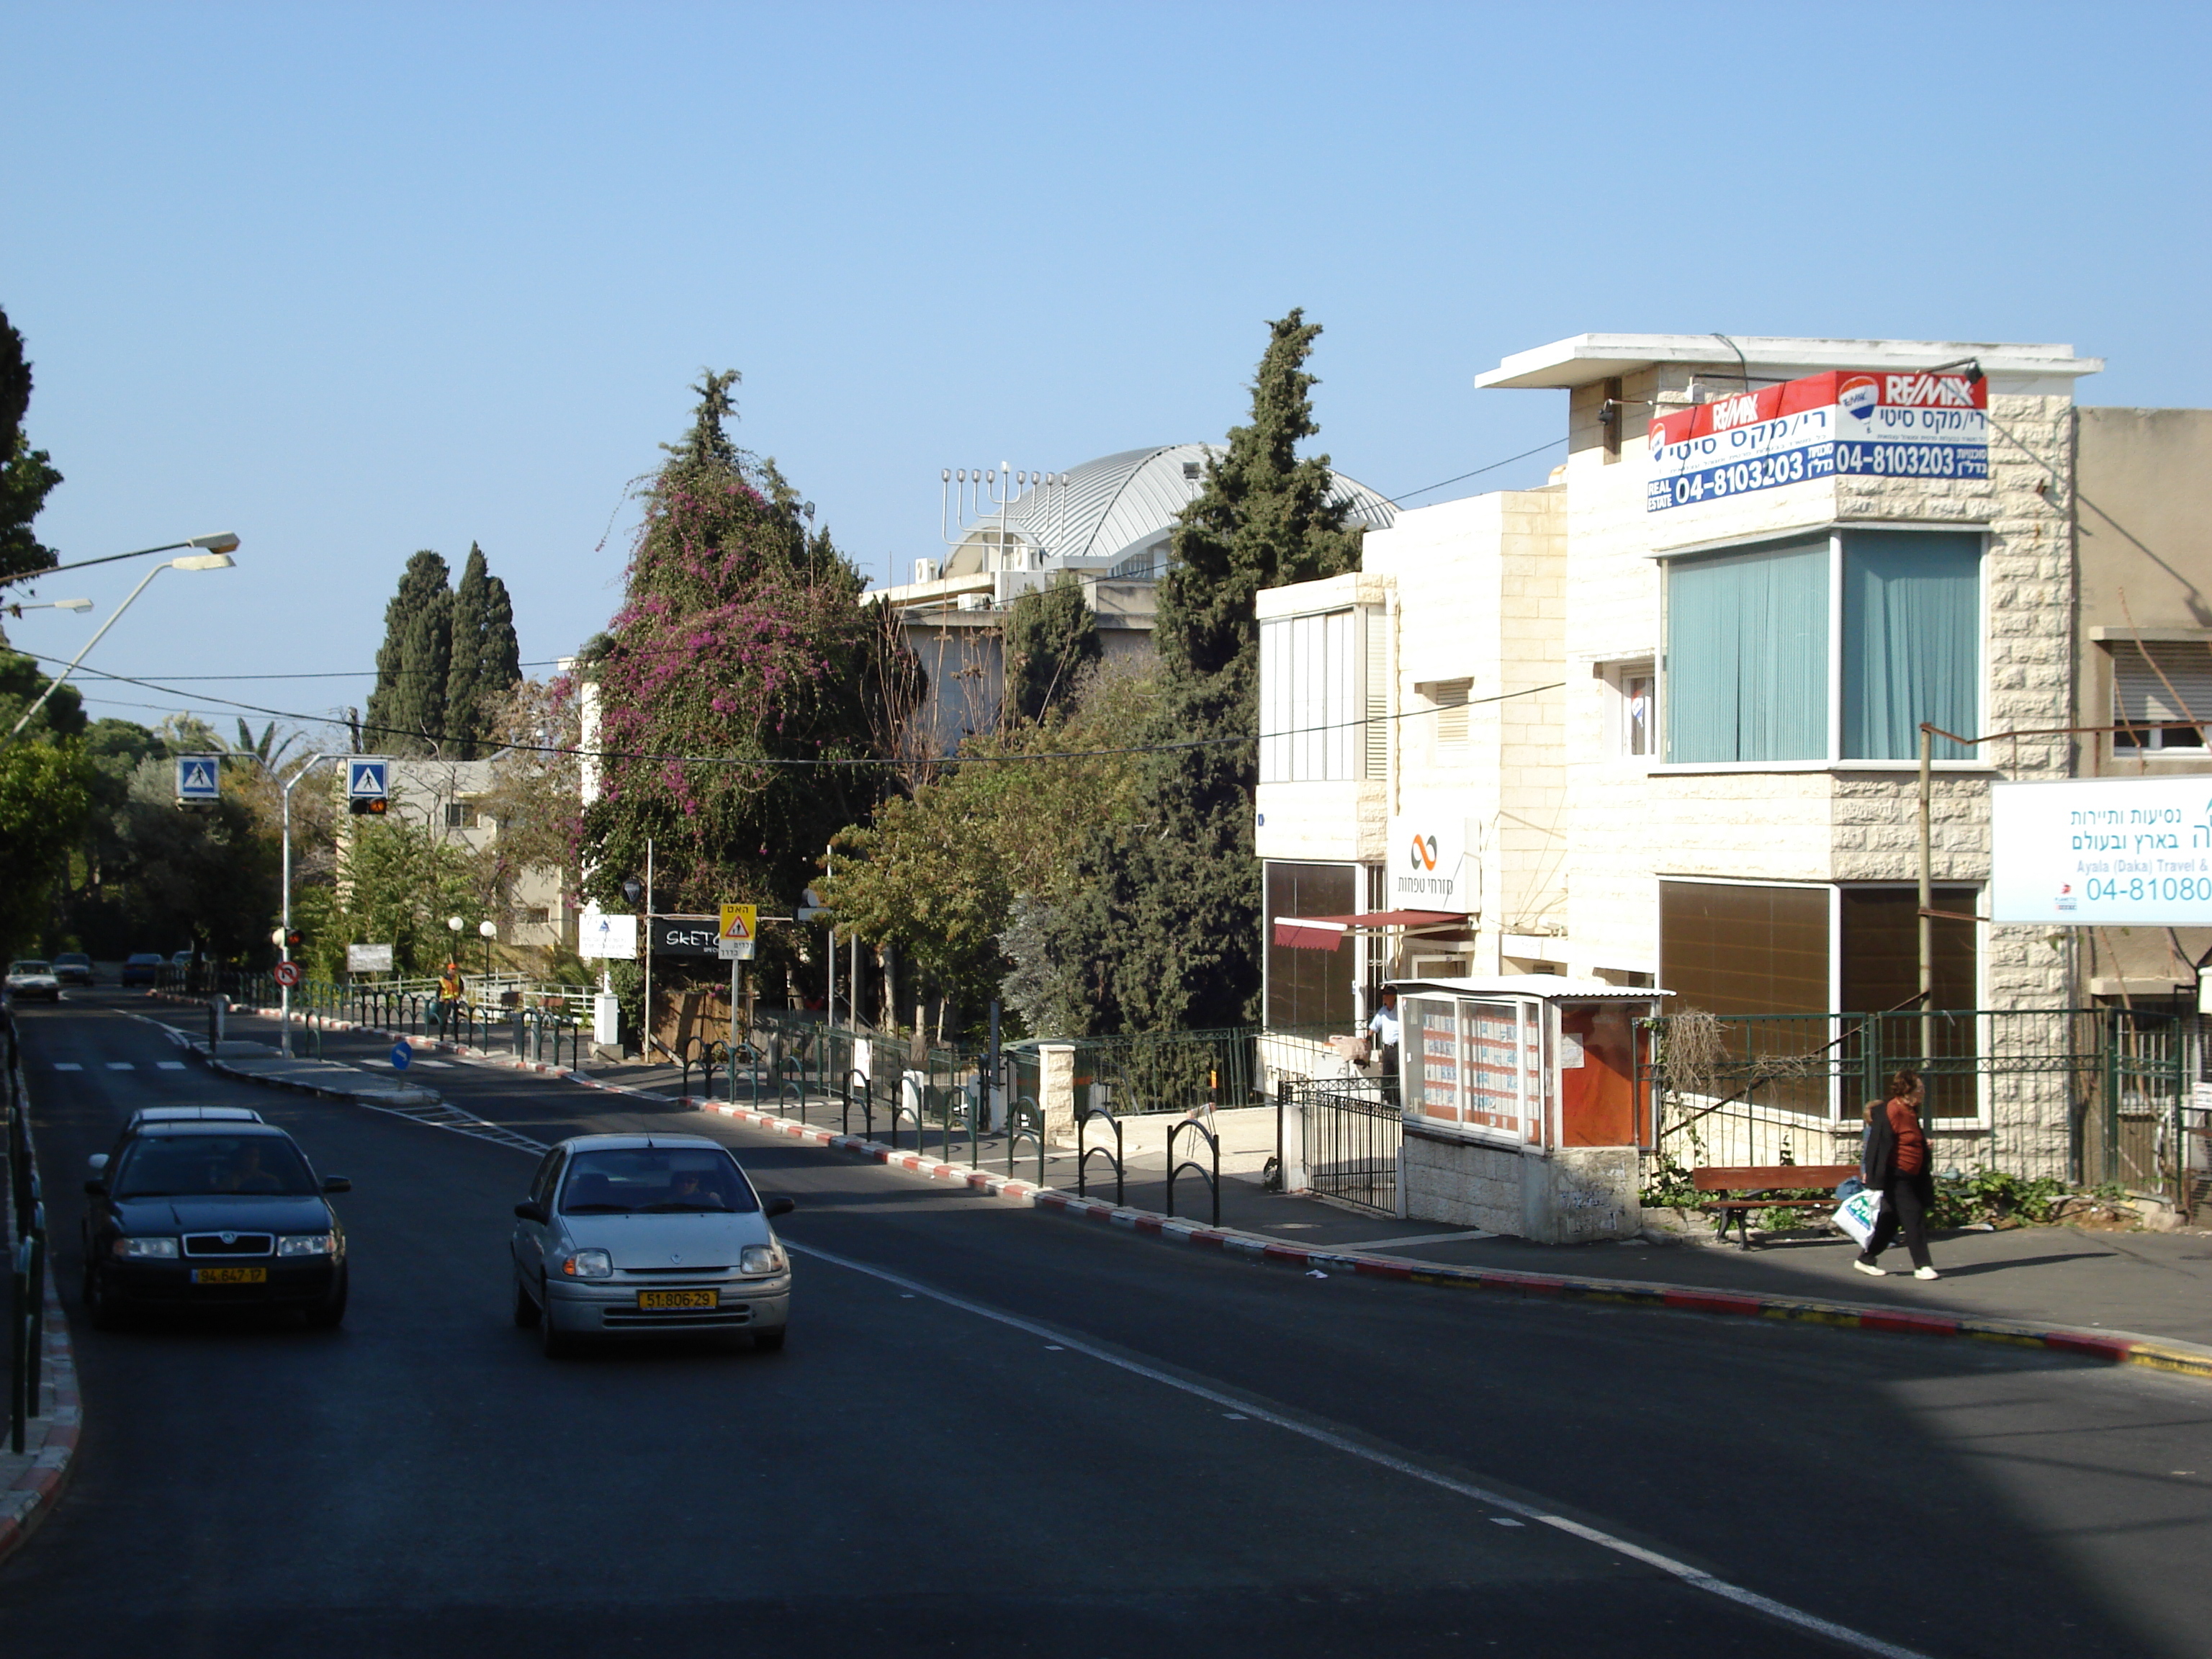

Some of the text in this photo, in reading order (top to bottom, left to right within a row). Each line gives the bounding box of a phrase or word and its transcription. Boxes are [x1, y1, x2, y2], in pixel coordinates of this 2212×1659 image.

[1886, 374, 1974, 406] RE/MAX
[1713, 393, 1759, 431] RE/MAX
[1880, 409, 1984, 433] רי/מקס סיטי
[1731, 410, 1826, 449] רי/מקס
[1670, 438, 1717, 461] סיטי
[1837, 444, 1954, 475] 04-8103203
[1648, 480, 1672, 496] REAL
[1676, 452, 1803, 504] 04-8103203
[1647, 495, 1673, 511] ESTATE
[2071, 809, 2181, 825] נסיעות ותיירות
[2072, 830, 2179, 855] בארץ ובעולם
[2077, 860, 2110, 876] Ayala
[2114, 859, 2152, 876] (Daka)
[2157, 858, 2195, 872] Travel
[1398, 876, 1425, 893] טפחות
